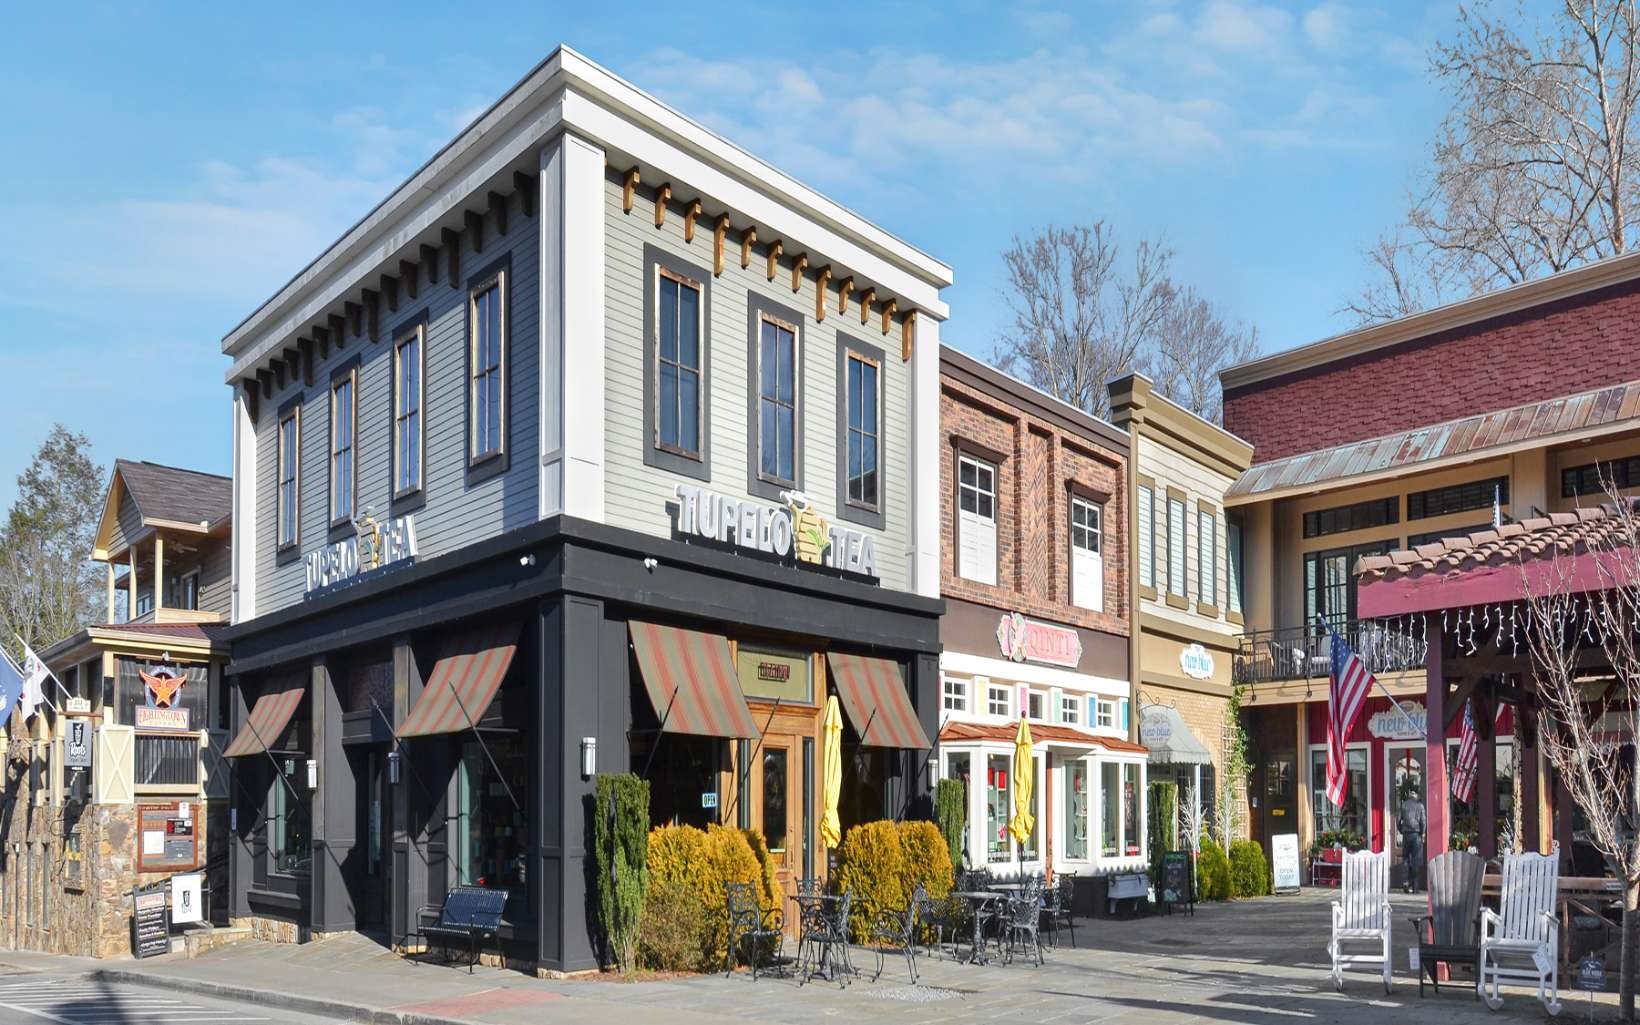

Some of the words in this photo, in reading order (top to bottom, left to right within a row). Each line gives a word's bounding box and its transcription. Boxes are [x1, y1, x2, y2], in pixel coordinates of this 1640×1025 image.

[675, 484, 791, 556] TUPELO
[826, 524, 876, 577] TEA
[304, 536, 359, 592] TUPELO
[379, 515, 418, 568] TEA
[1029, 628, 1071, 656] QINTI
[1377, 717, 1405, 732] new
[1407, 711, 1427, 729] blu
[70, 741, 86, 757] Roots
[704, 795, 716, 806] OPEN
